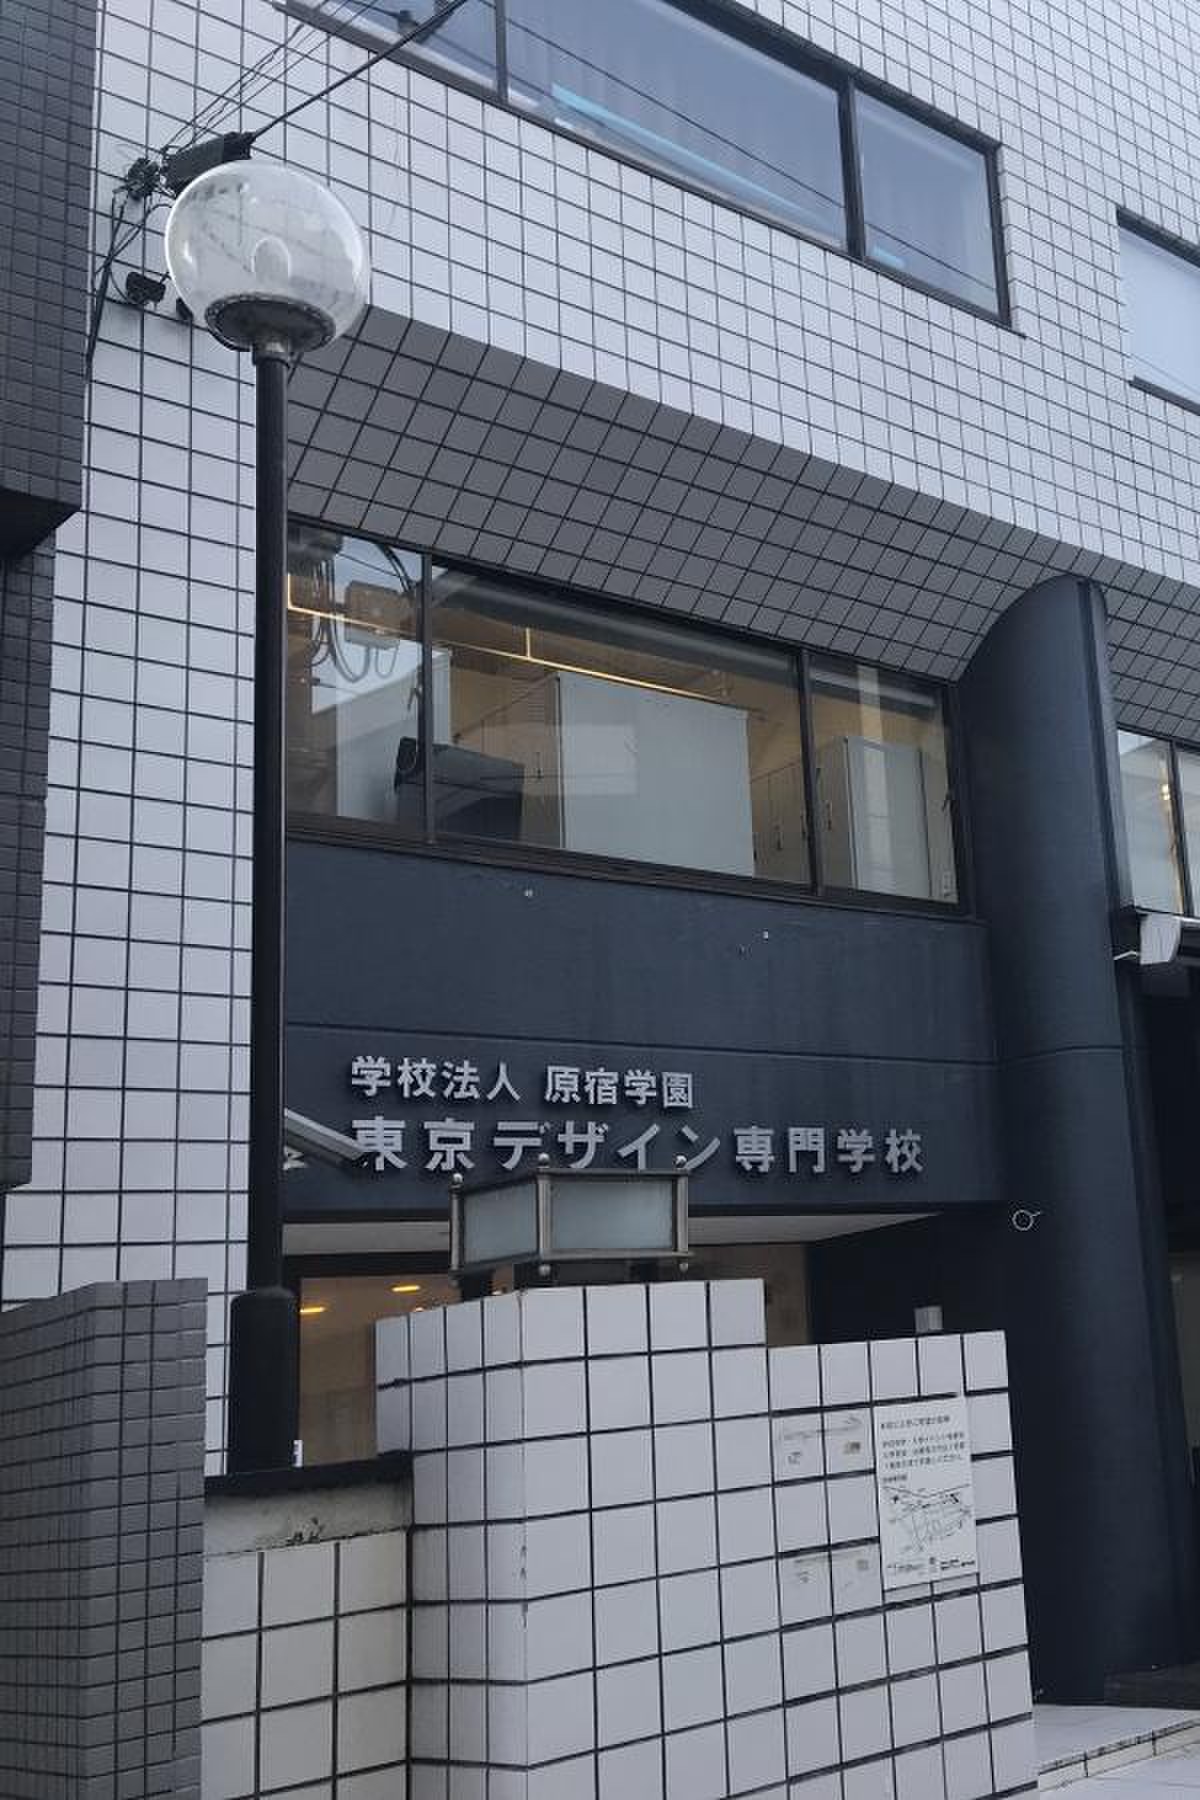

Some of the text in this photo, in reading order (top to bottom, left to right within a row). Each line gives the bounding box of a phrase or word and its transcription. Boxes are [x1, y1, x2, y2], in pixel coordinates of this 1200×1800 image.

[351, 1055, 694, 1109] 学校法人 原宿学園
[351, 1115, 924, 1174] 東京デザイン専門学校
